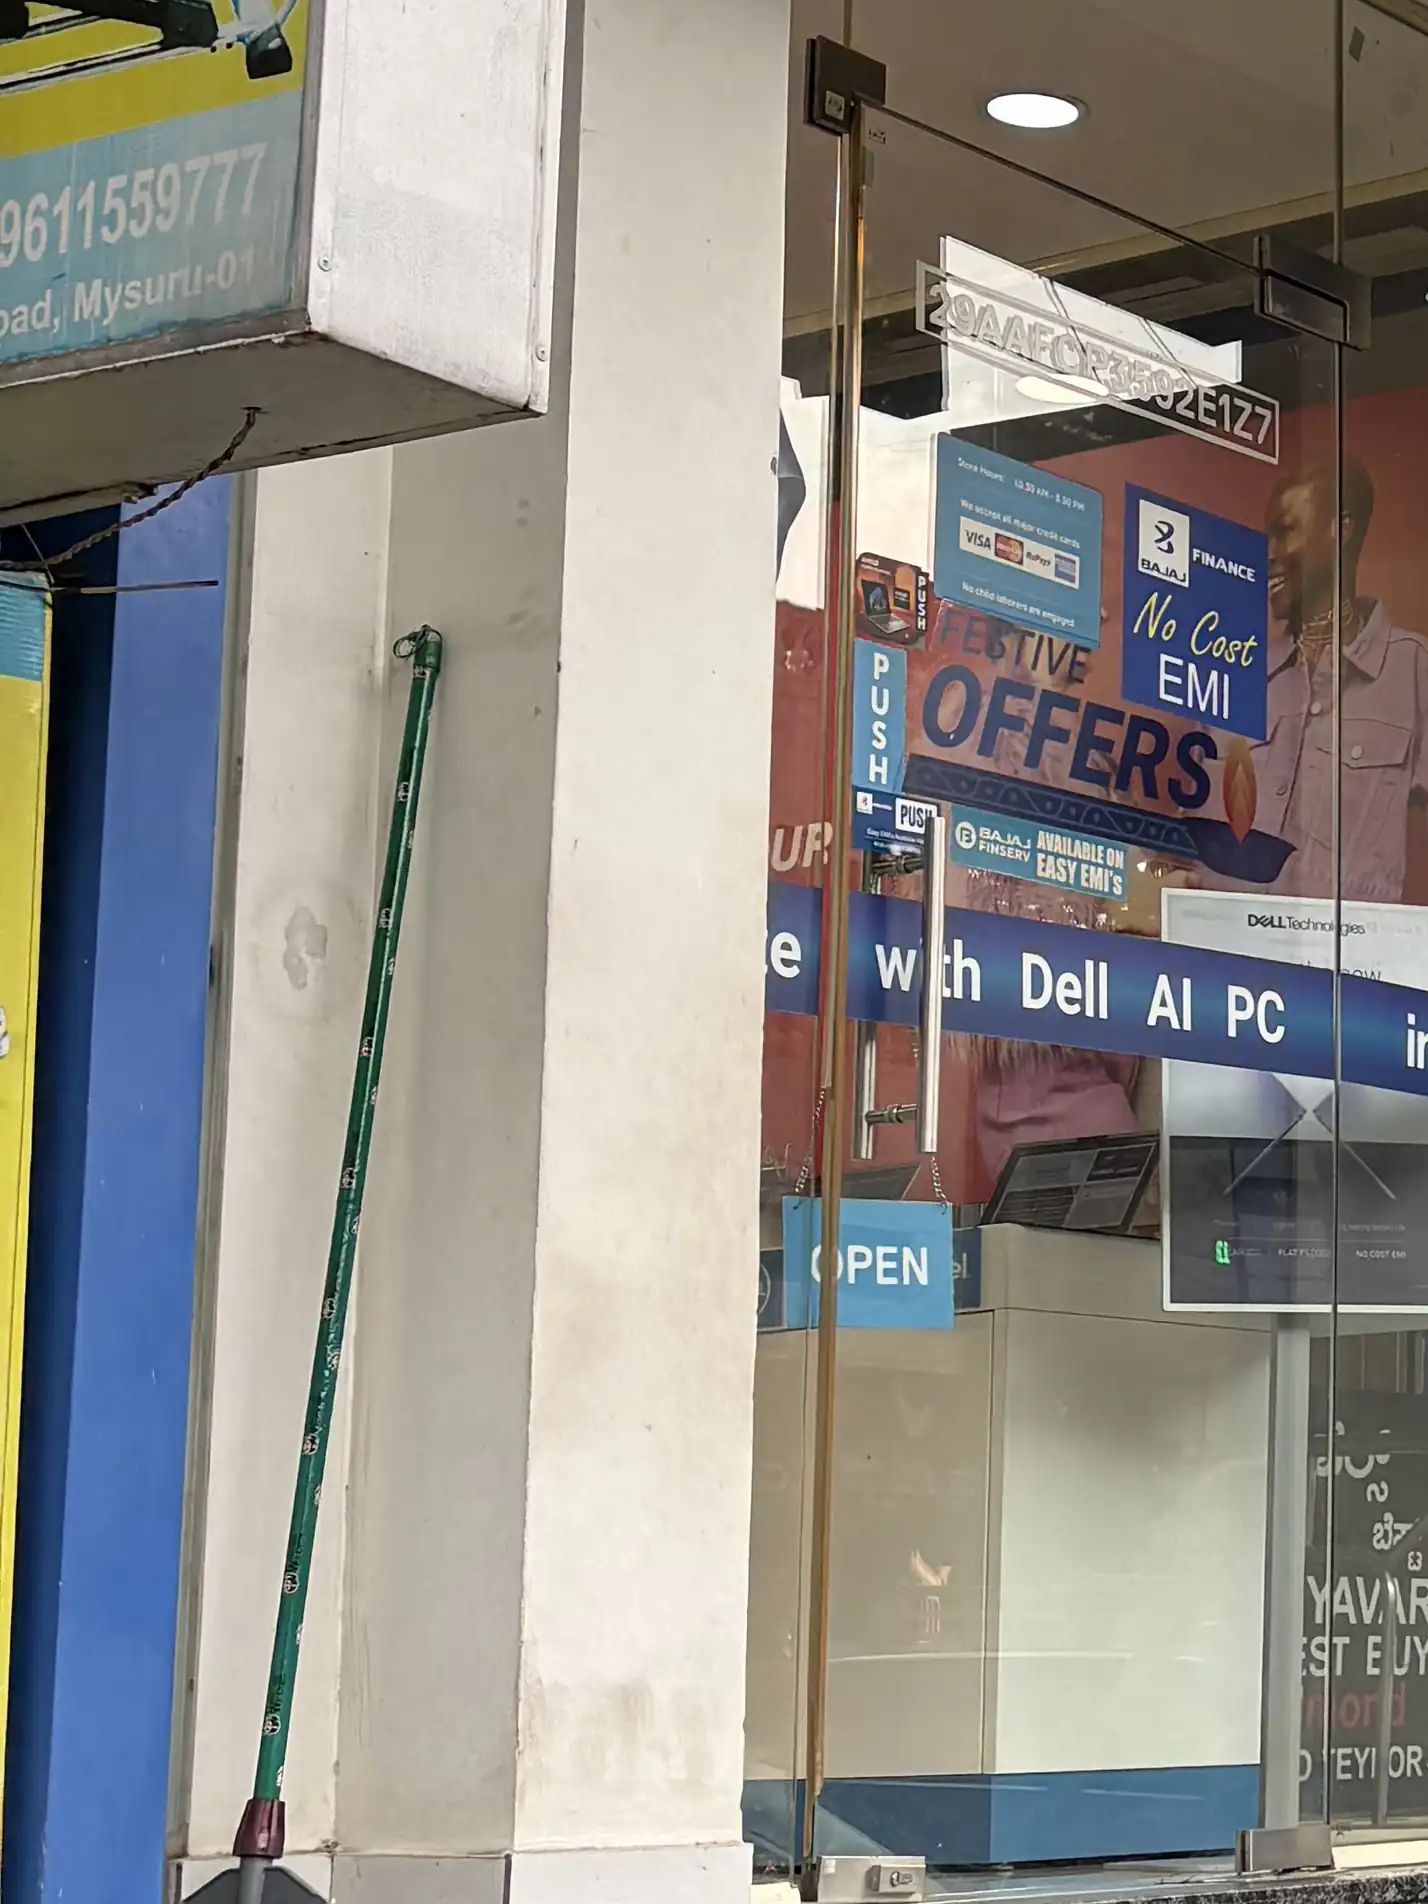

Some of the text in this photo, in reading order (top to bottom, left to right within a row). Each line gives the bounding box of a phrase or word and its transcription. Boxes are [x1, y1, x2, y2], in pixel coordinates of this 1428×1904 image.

[0, 142, 268, 268] 9611559777
[72, 249, 258, 327] Mysuru-01
[965, 528, 992, 551] VISA
[1140, 557, 1188, 586] BAJAJ
[1191, 547, 1256, 584] FINANCE
[916, 574, 925, 631] PUSH
[939, 608, 1092, 684] FESTIVE
[1132, 590, 1258, 668] No Cost
[1156, 651, 1232, 720] EMI
[868, 652, 890, 785] PUSH
[920, 664, 1220, 812] OFFERS
[900, 804, 934, 827] PUSH
[979, 826, 1032, 849] BAJAJ
[979, 842, 1031, 863] FINSERV
[1037, 830, 1096, 869] AVAILABLE
[1036, 853, 1077, 881] EASY
[1247, 914, 1285, 929] DELL
[875, 935, 982, 1002] wth
[1021, 951, 1109, 1020] Dell
[1147, 977, 1192, 1032] AI
[1227, 985, 1285, 1044] PC
[810, 1245, 931, 1287] OPEN
